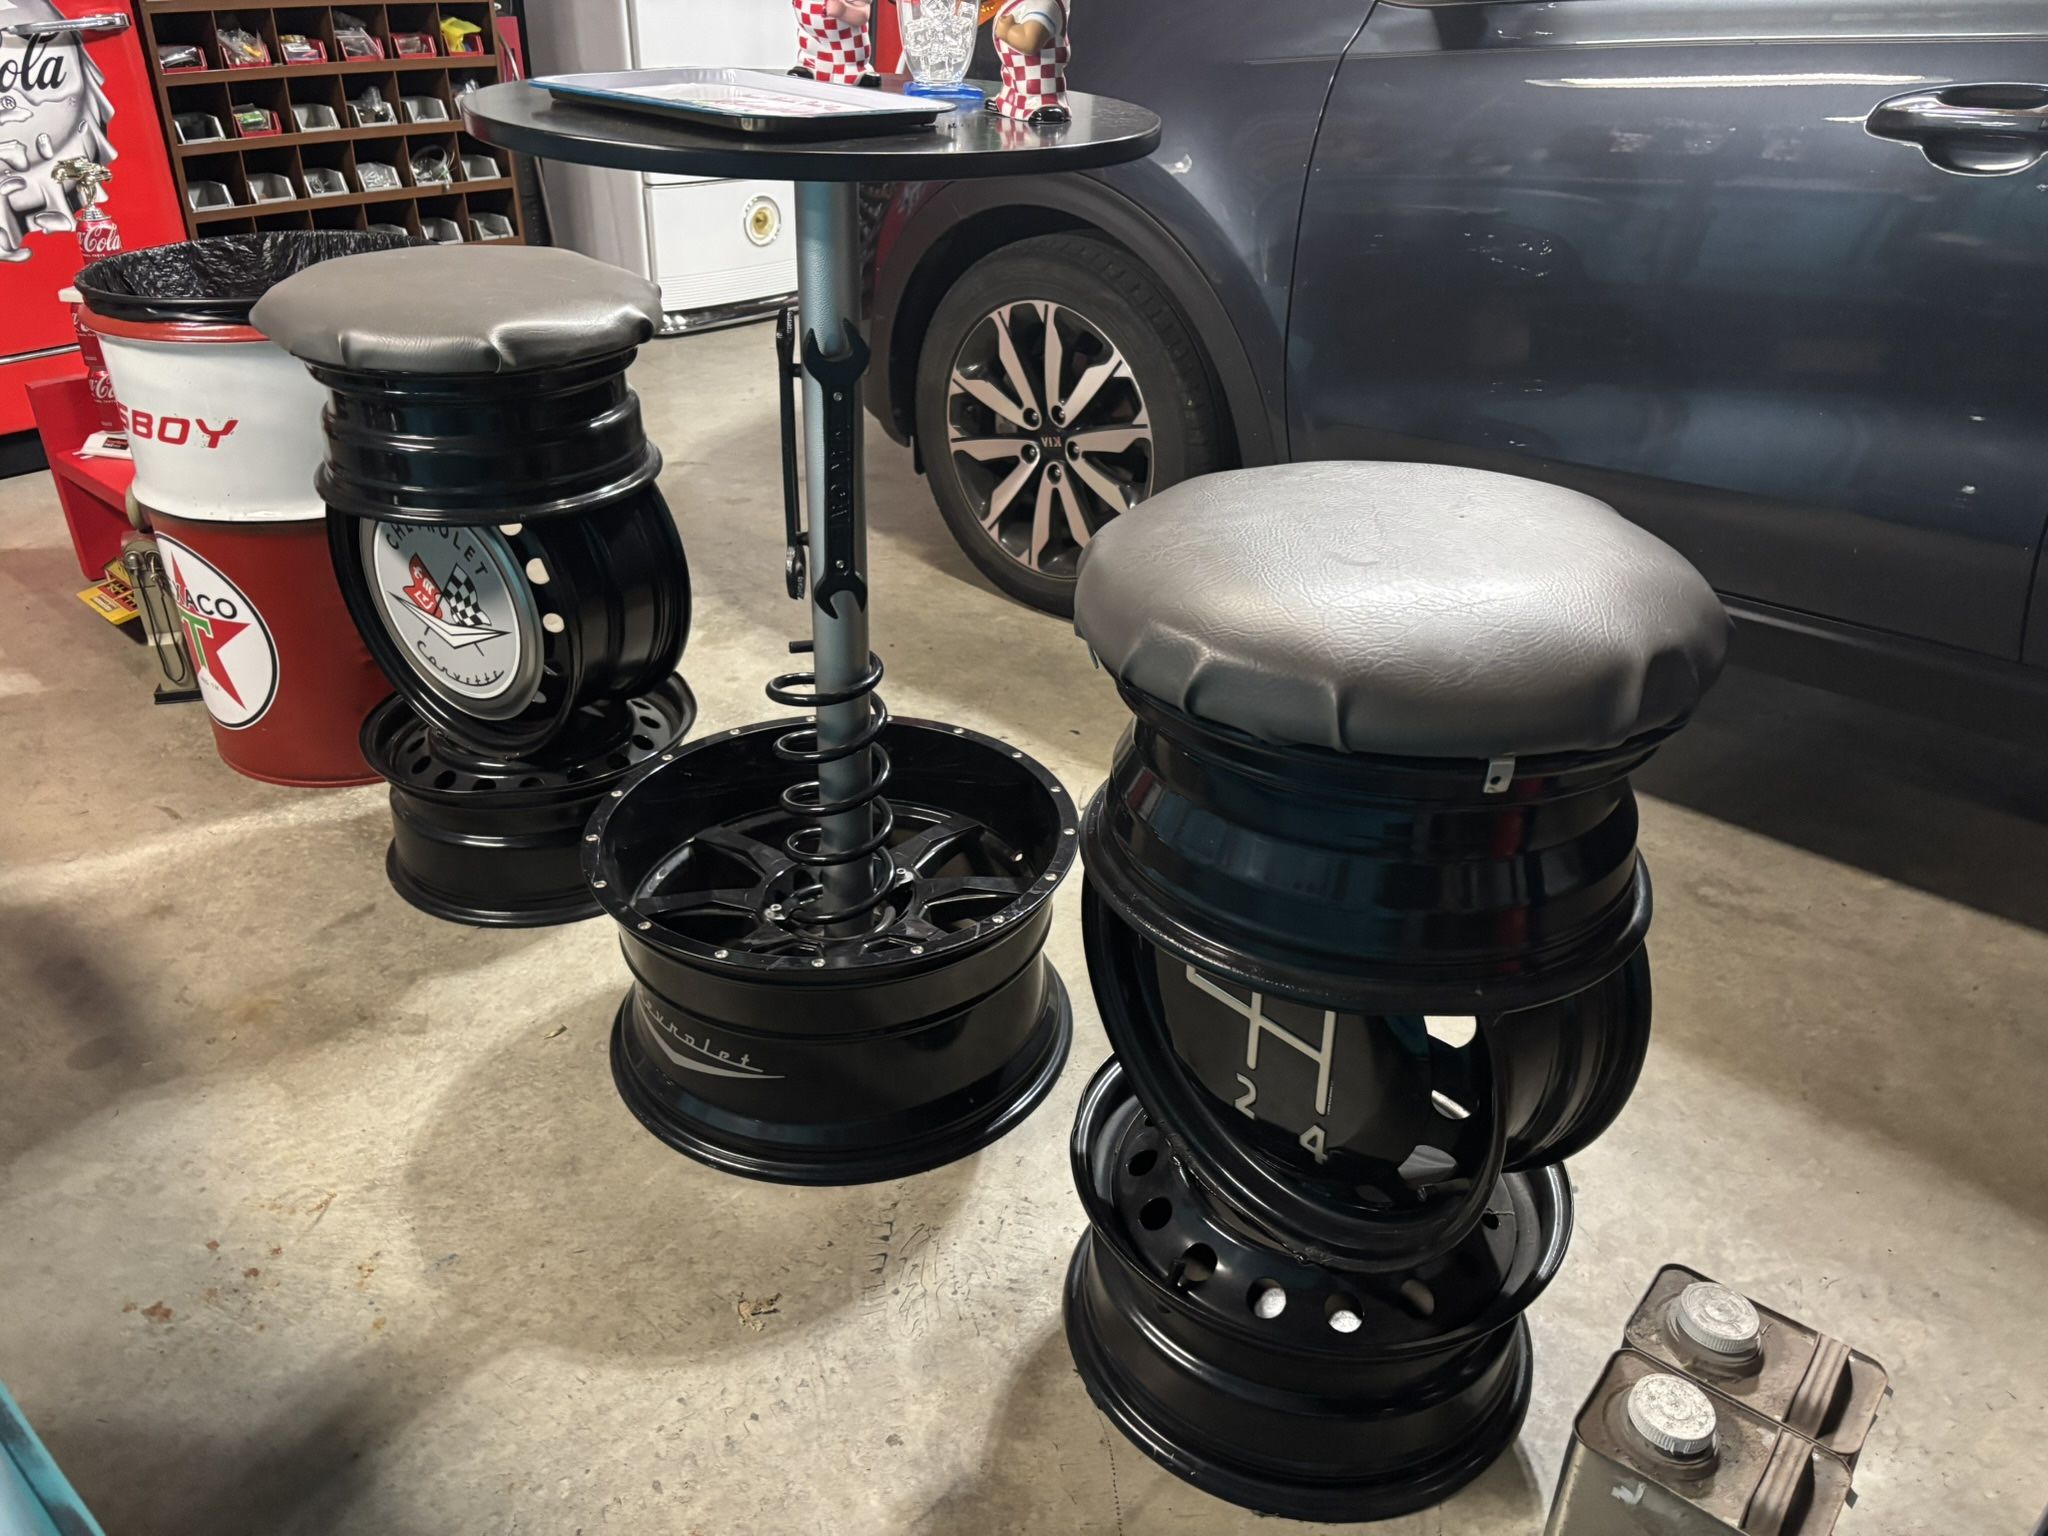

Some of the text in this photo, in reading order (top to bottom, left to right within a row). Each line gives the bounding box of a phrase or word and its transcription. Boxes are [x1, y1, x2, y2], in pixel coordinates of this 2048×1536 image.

[0, 33, 67, 93] ola
[1234, 1072, 1257, 1120] 2
[1300, 1124, 1328, 1165] 4
